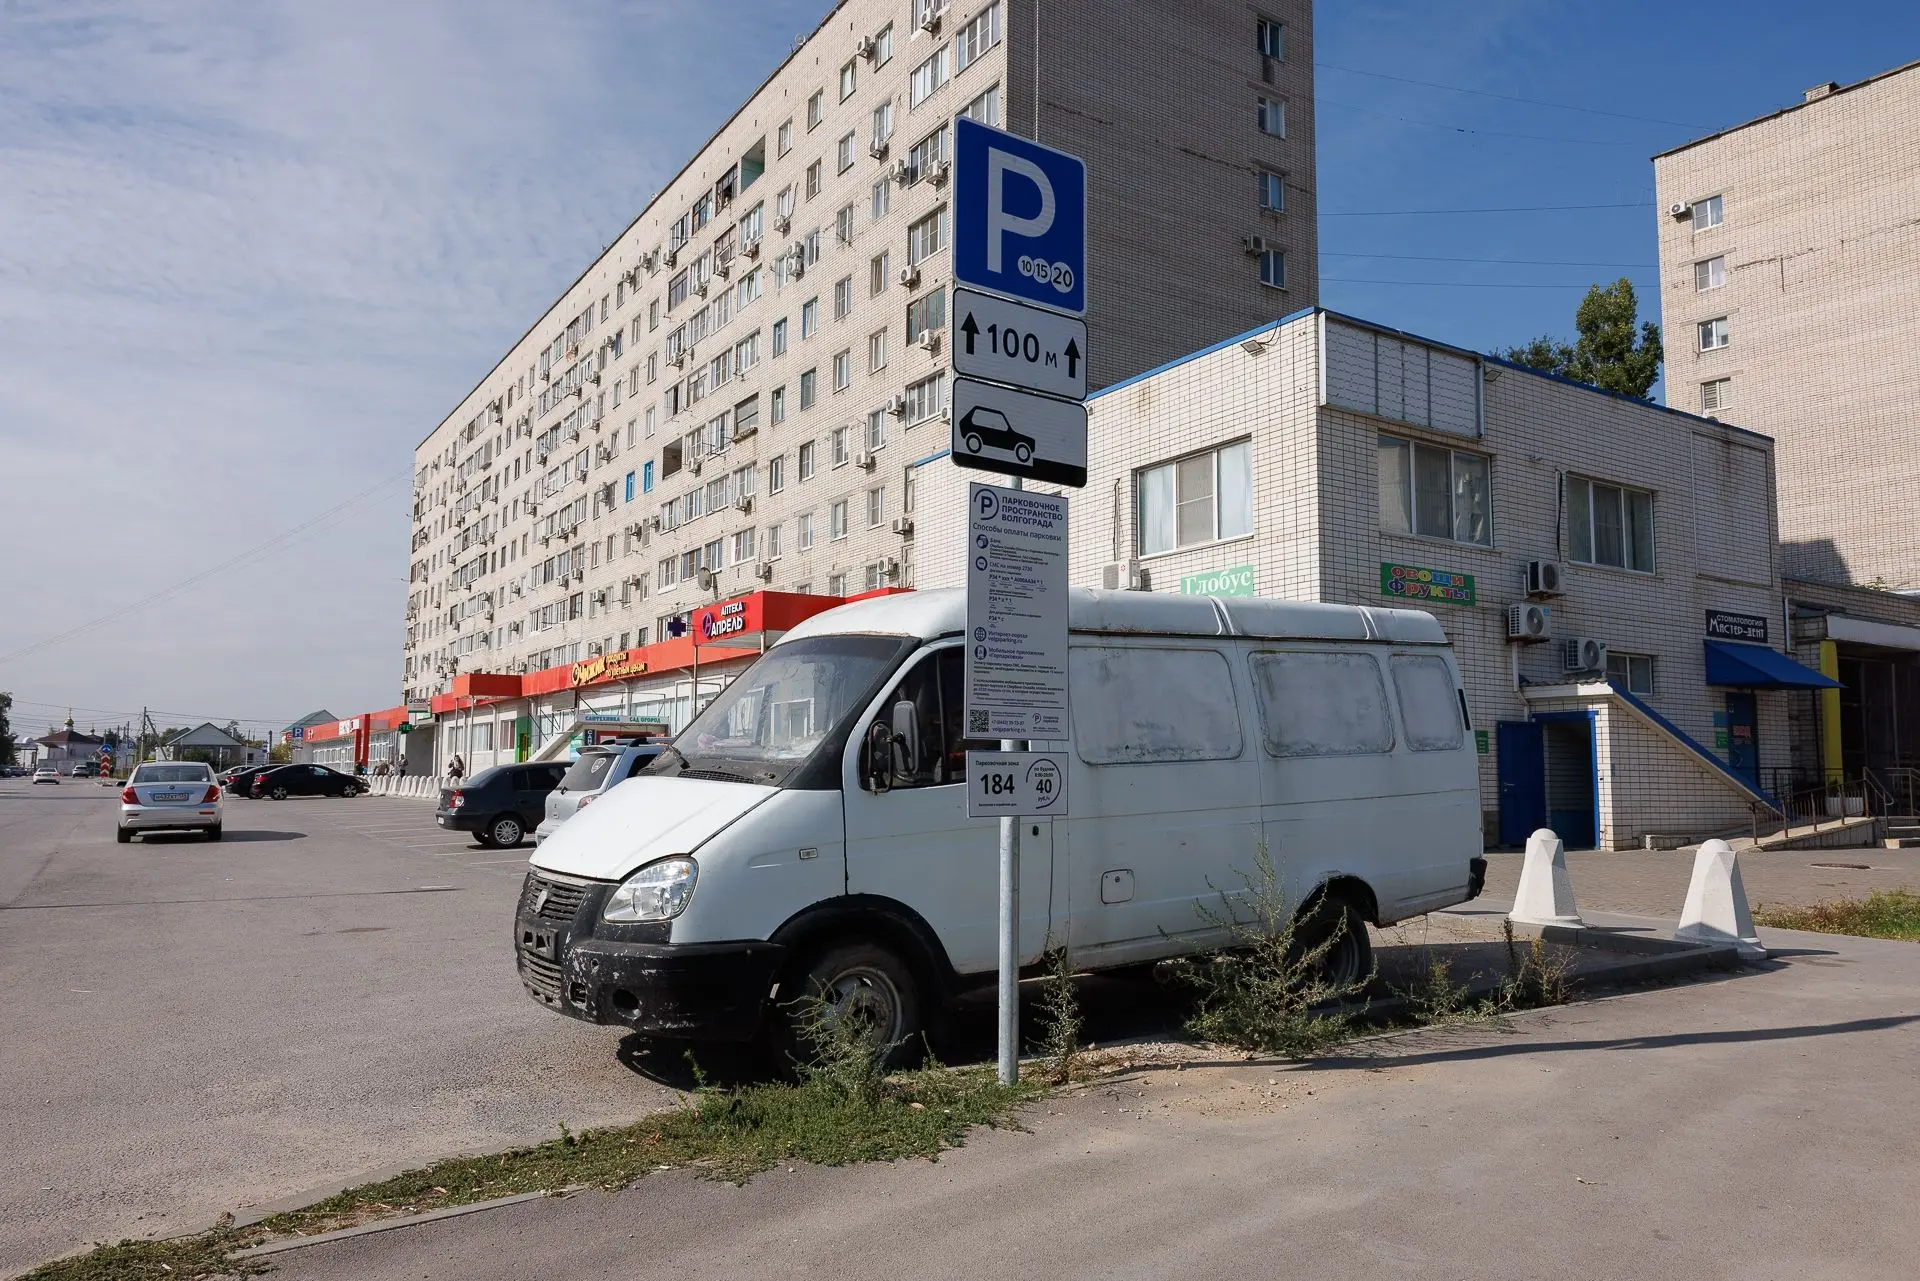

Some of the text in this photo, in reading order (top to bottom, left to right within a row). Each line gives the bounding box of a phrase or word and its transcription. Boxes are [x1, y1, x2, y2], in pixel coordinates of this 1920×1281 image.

[987, 146, 1056, 273] P
[1021, 259, 1072, 288] 10 15 20
[987, 323, 1040, 363] 100
[1001, 505, 1063, 521] ПРОСТРАНСТВО
[1002, 496, 1060, 512] ПАРКОВОЧНОЕ
[1001, 514, 1053, 528] ВОЛГОГРАДА
[972, 522, 1061, 542] Способы оплаты парковки
[1184, 569, 1251, 595] Глобус
[720, 601, 744, 617] АПТЕКА
[710, 615, 745, 637] АПРЕЛЬ
[1716, 614, 1764, 627] СТОМАТОЛОГИЯ
[980, 773, 1015, 795] 184
[1035, 778, 1052, 794] 40
